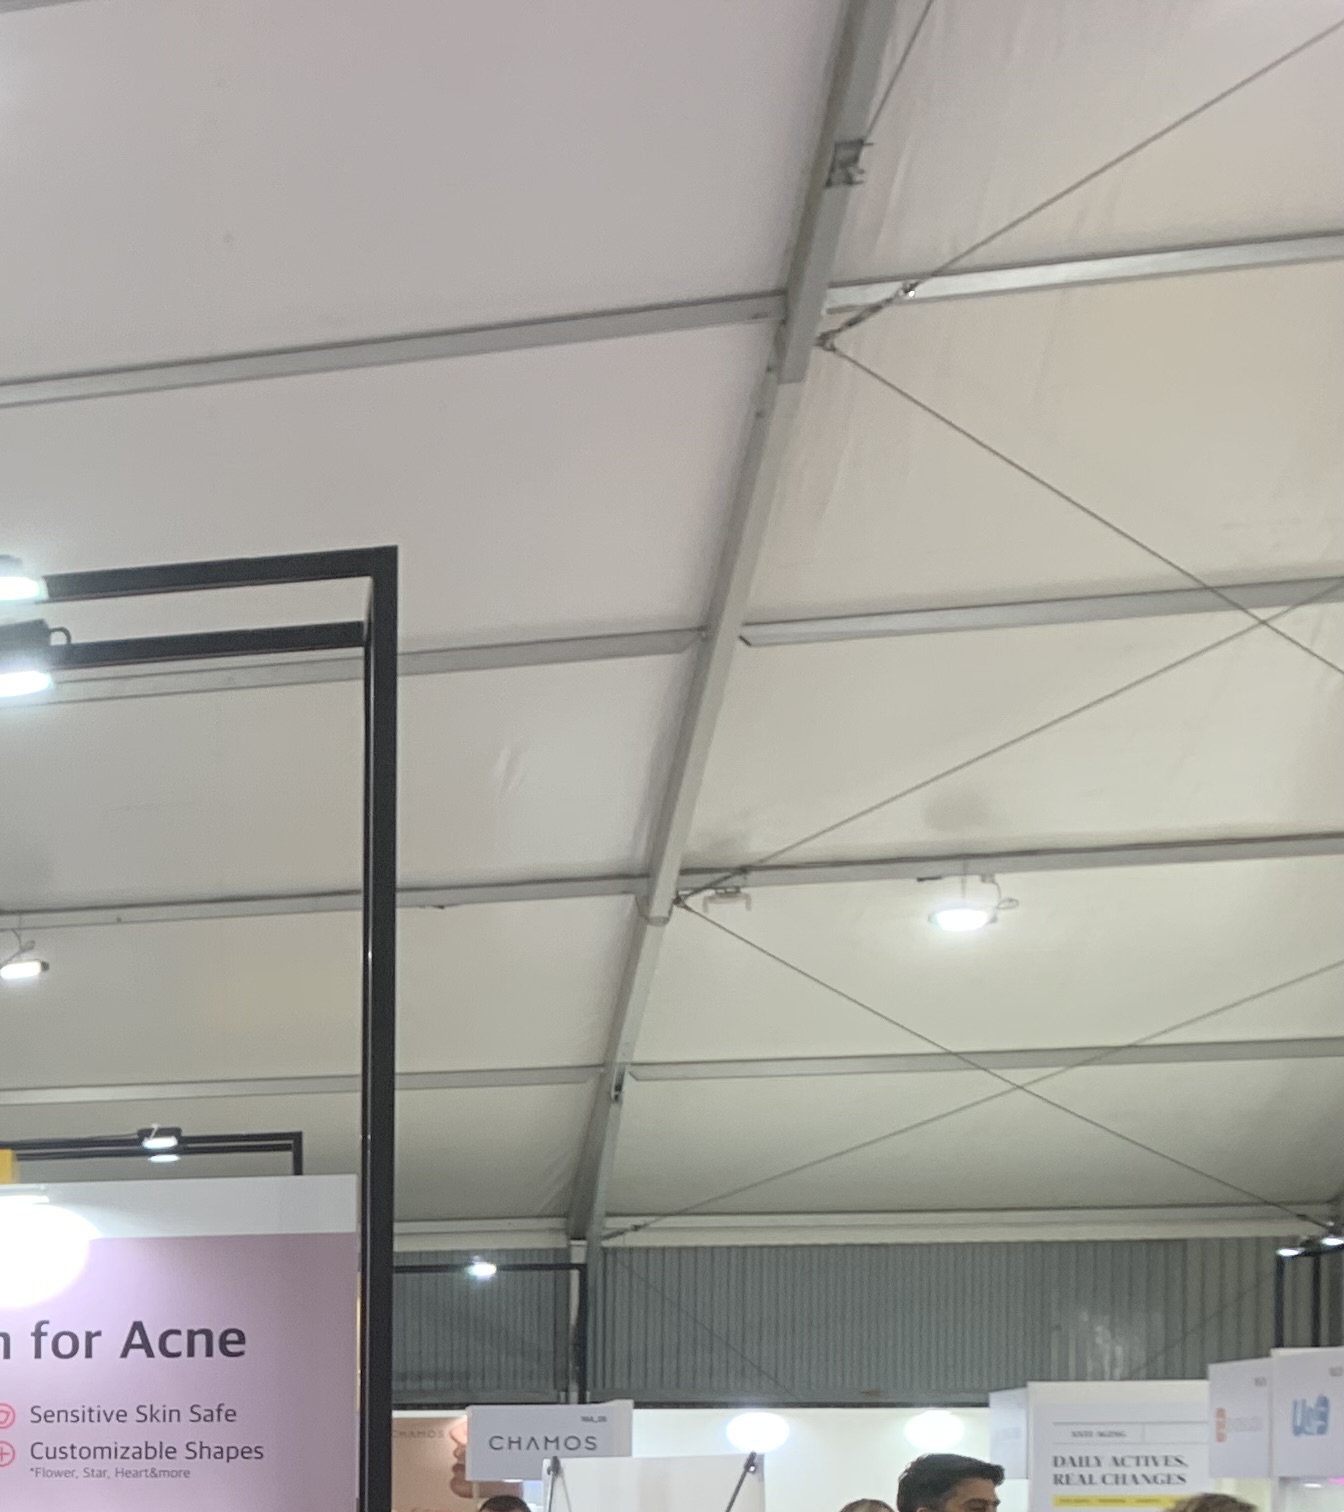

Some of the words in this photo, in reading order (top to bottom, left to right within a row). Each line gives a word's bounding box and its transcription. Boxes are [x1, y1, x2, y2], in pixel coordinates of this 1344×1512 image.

[30, 1319, 103, 1360] for
[119, 1320, 247, 1359] Acne
[30, 1404, 128, 1424] Sensitive
[135, 1403, 182, 1424] Skin
[189, 1403, 237, 1423] Safe
[488, 1435, 598, 1451] CHAMOS
[30, 1441, 178, 1461] Customizable
[184, 1440, 265, 1463] Shapes
[1052, 1455, 1104, 1468] DAILY
[82, 1466, 111, 1480] Star,
[114, 1466, 191, 1479] Heart&more
[1052, 1473, 1099, 1486] REAL
[1101, 1473, 1188, 1486] CHANGES
